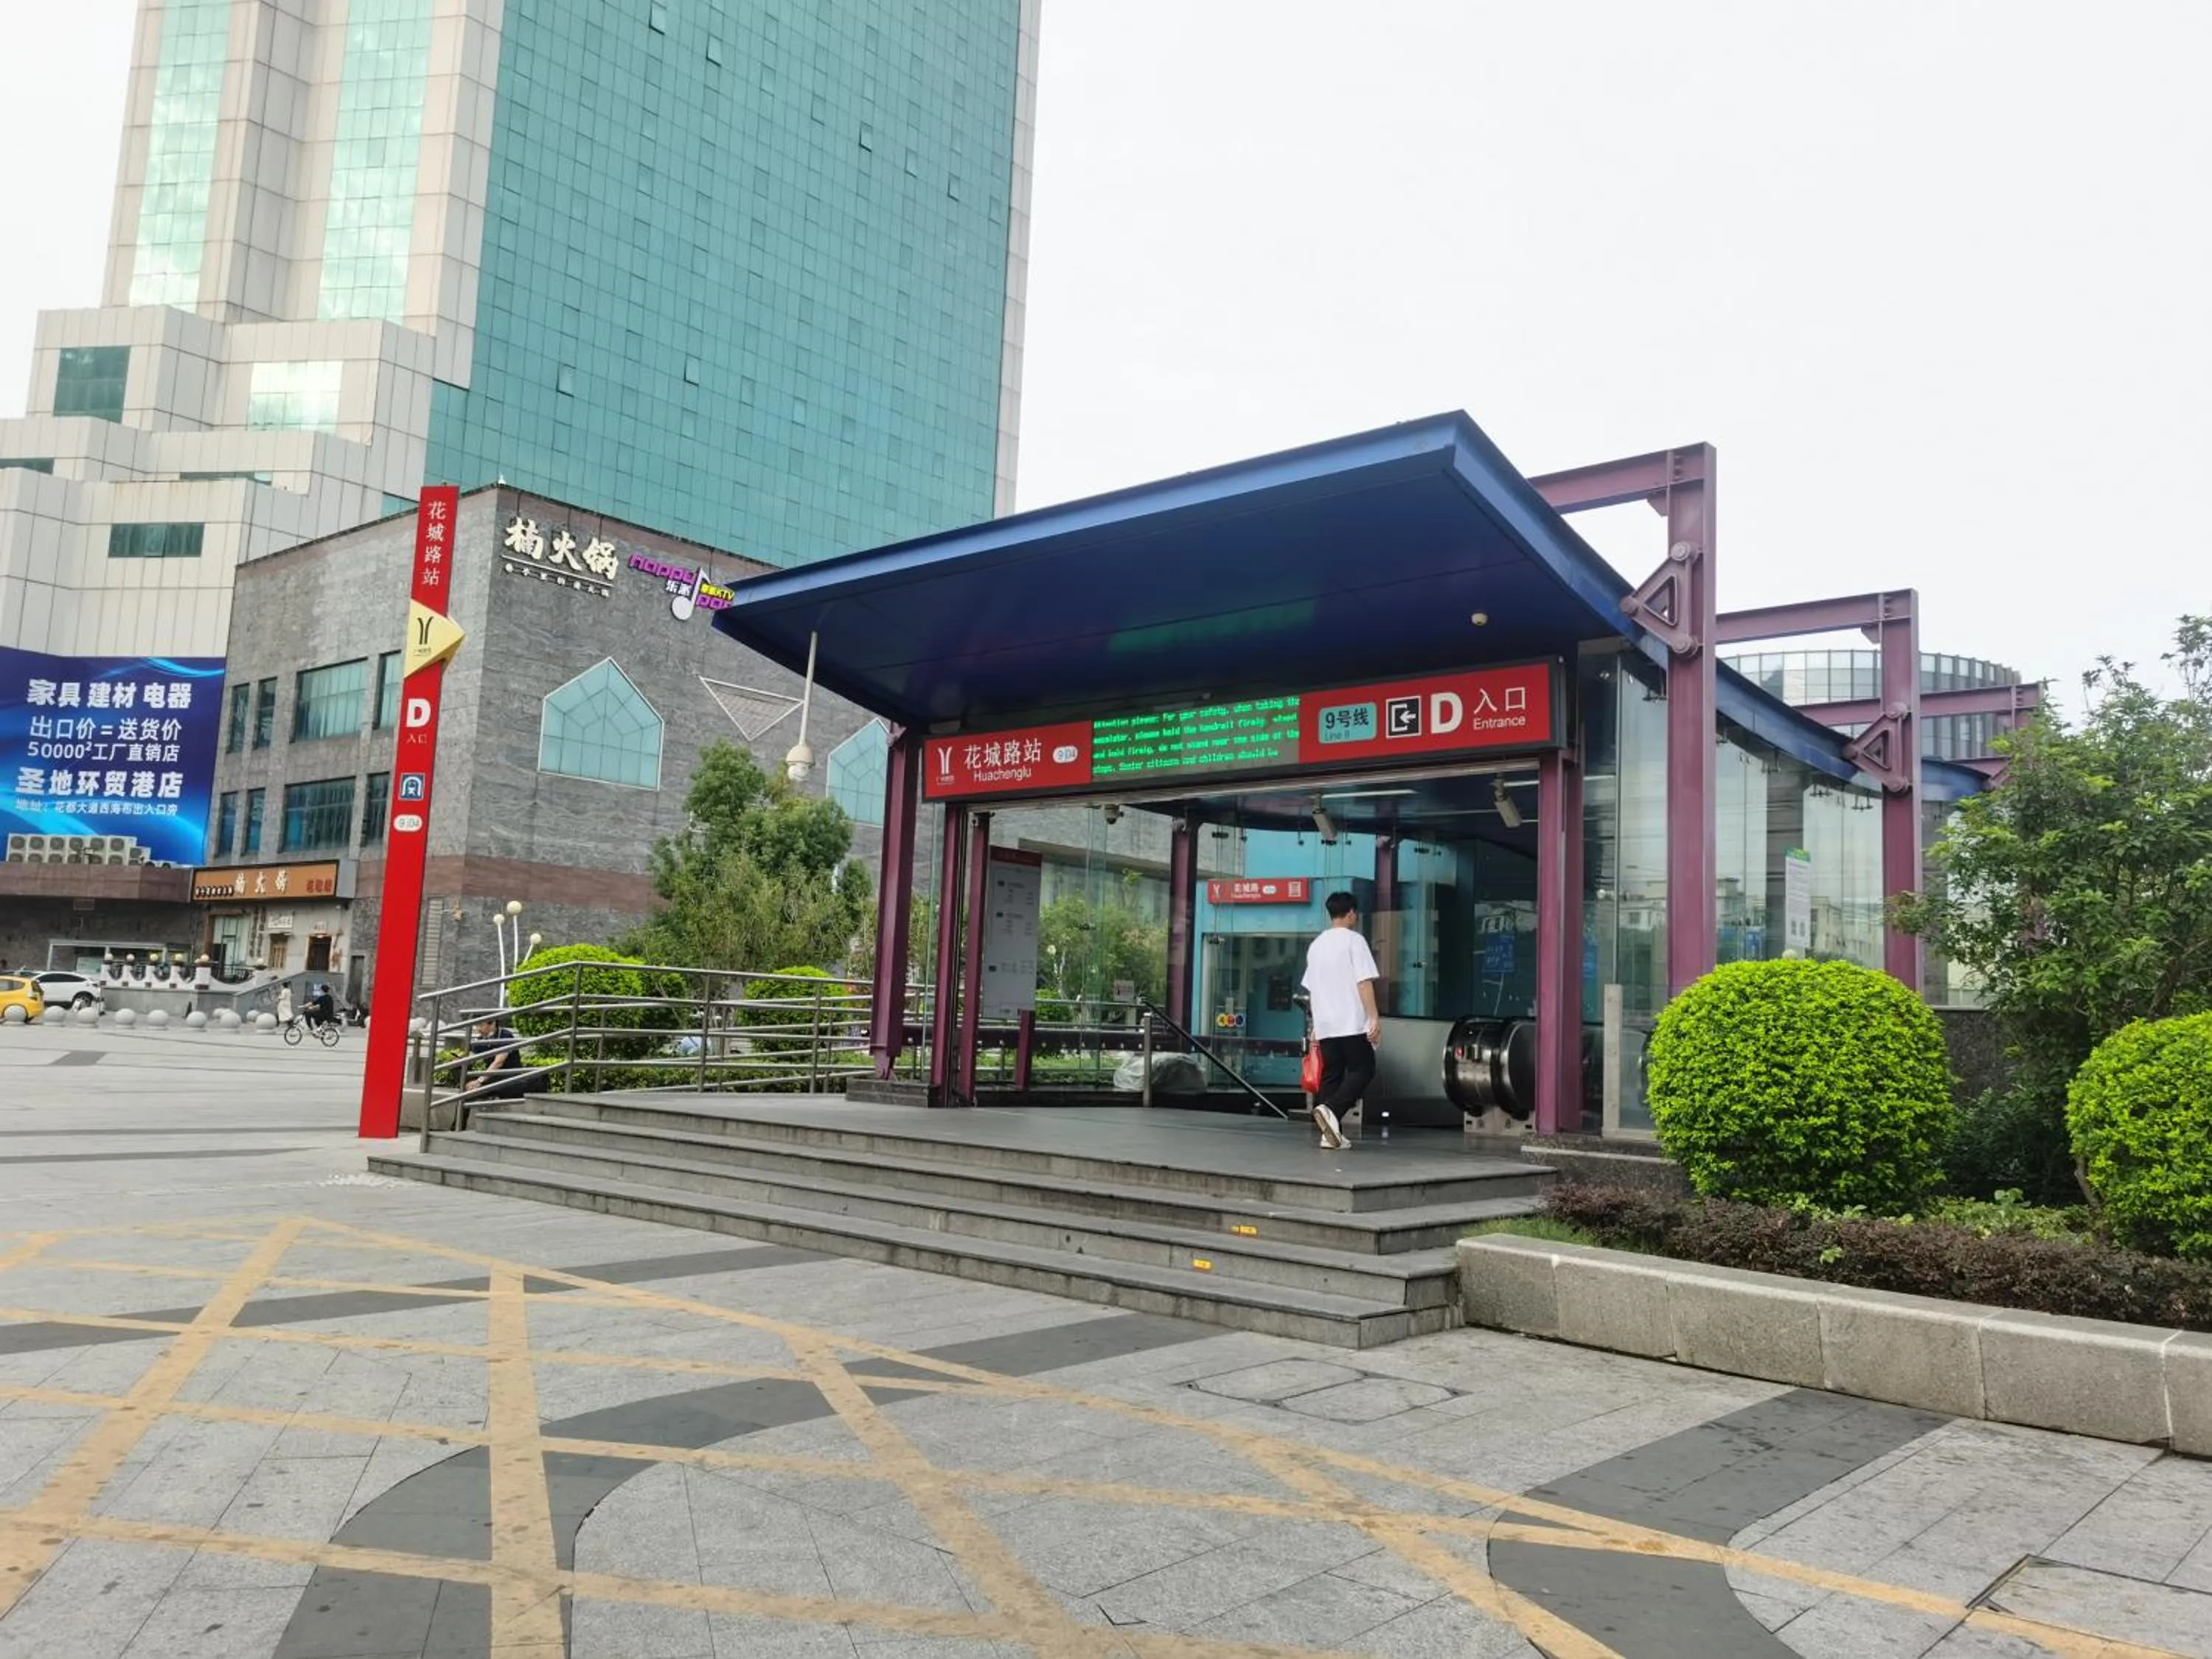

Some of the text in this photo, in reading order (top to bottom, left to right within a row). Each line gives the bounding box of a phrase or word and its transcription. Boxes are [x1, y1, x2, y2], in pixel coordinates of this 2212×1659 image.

[422, 501, 447, 587] 花城路站
[504, 518, 619, 581] 楠火锅
[27, 679, 192, 709] 家具 建材 电器
[1474, 686, 1526, 714] 入口
[406, 698, 431, 728] D
[1325, 708, 1369, 729] 9号线
[1430, 692, 1463, 734] D
[1473, 716, 1526, 730] Entrance
[406, 733, 428, 744] 入口
[963, 737, 1042, 771] 花城路站
[15, 767, 183, 799] 圣地环贸港店
[974, 766, 1032, 782] Huachenglu
